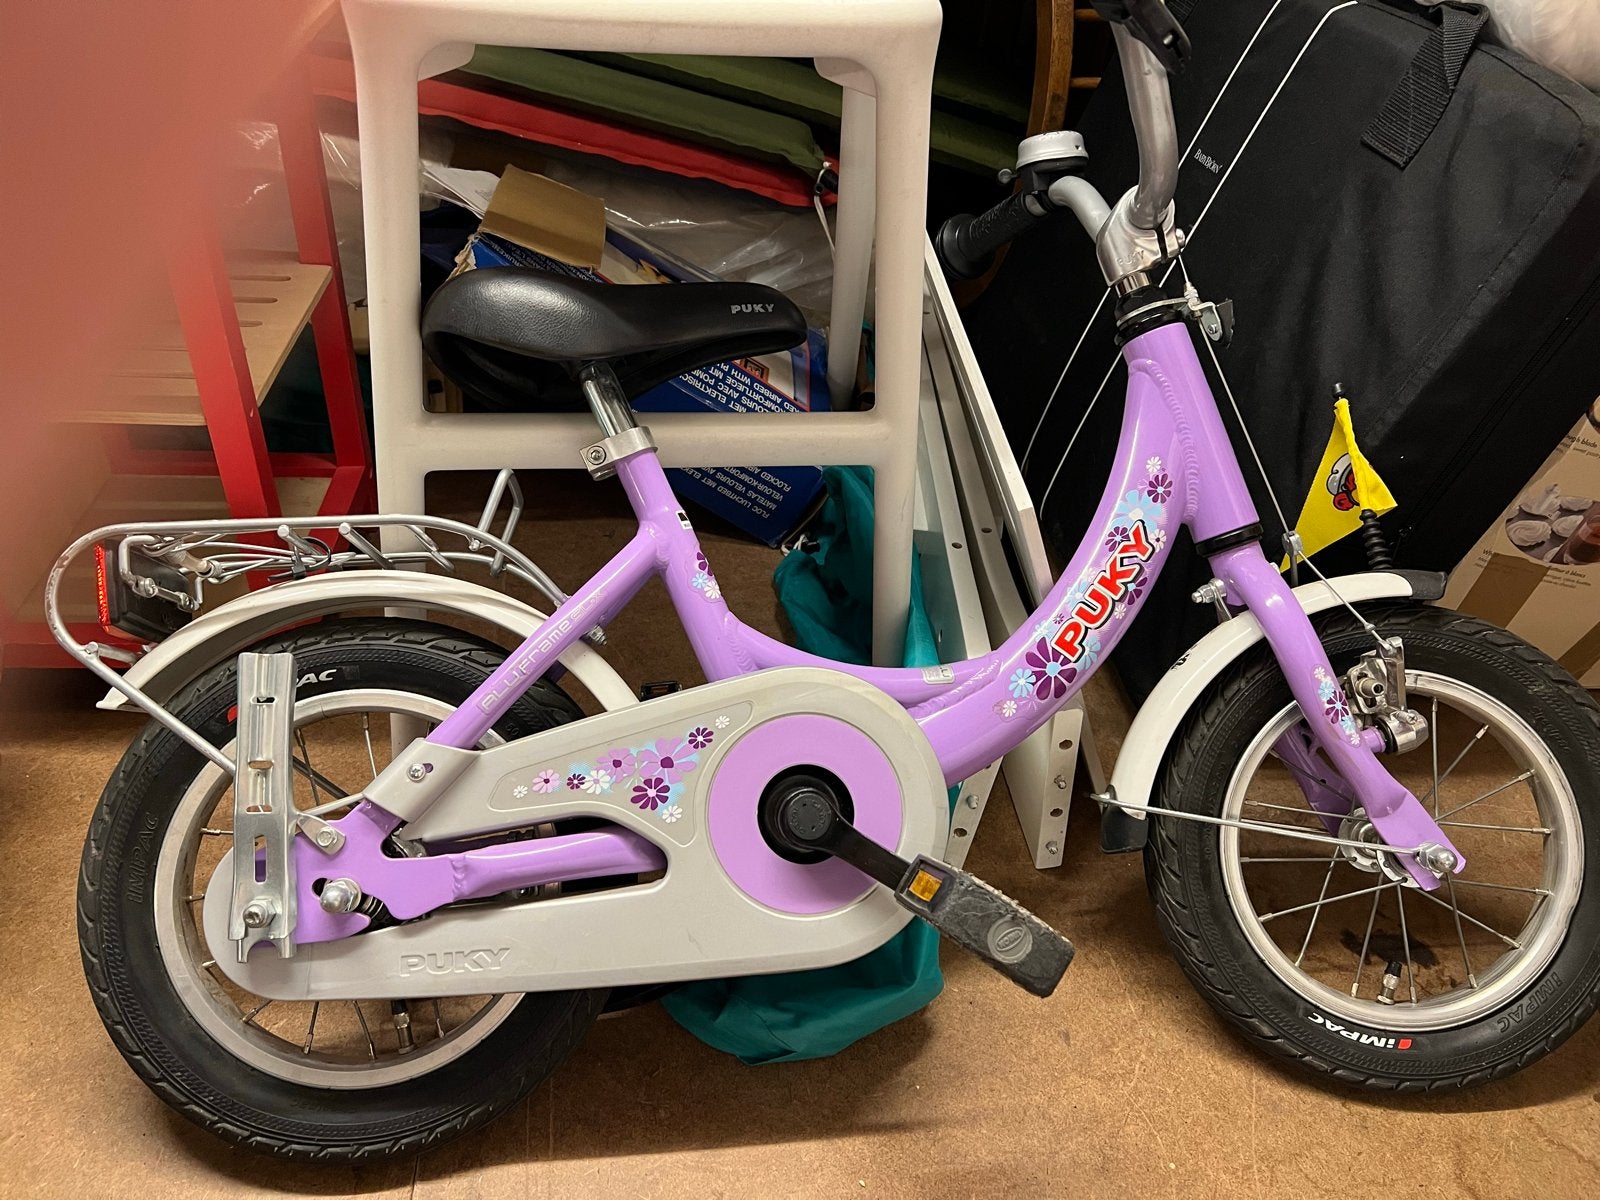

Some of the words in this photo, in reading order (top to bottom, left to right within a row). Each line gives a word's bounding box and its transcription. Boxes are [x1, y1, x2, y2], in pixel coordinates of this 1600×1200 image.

[730, 303, 775, 315] PUKY
[709, 366, 724, 380] MIT
[731, 369, 751, 386] WITH
[680, 373, 727, 404] ELEKTRISC
[717, 382, 740, 399] AVEC
[753, 382, 783, 404] AIRBED
[728, 400, 747, 413] MET
[742, 396, 769, 413] LOURS
[700, 477, 718, 488] MET
[715, 472, 746, 494] VELOURS
[723, 466, 784, 501] VELOUR-KOMFORT
[760, 471, 792, 492] FLOCKED
[717, 485, 752, 508] LUCHTBED
[747, 490, 778, 511] MATELAS
[752, 505, 770, 519] FLOC
[1051, 520, 1154, 661] PUKY
[400, 947, 511, 977] PUKY
